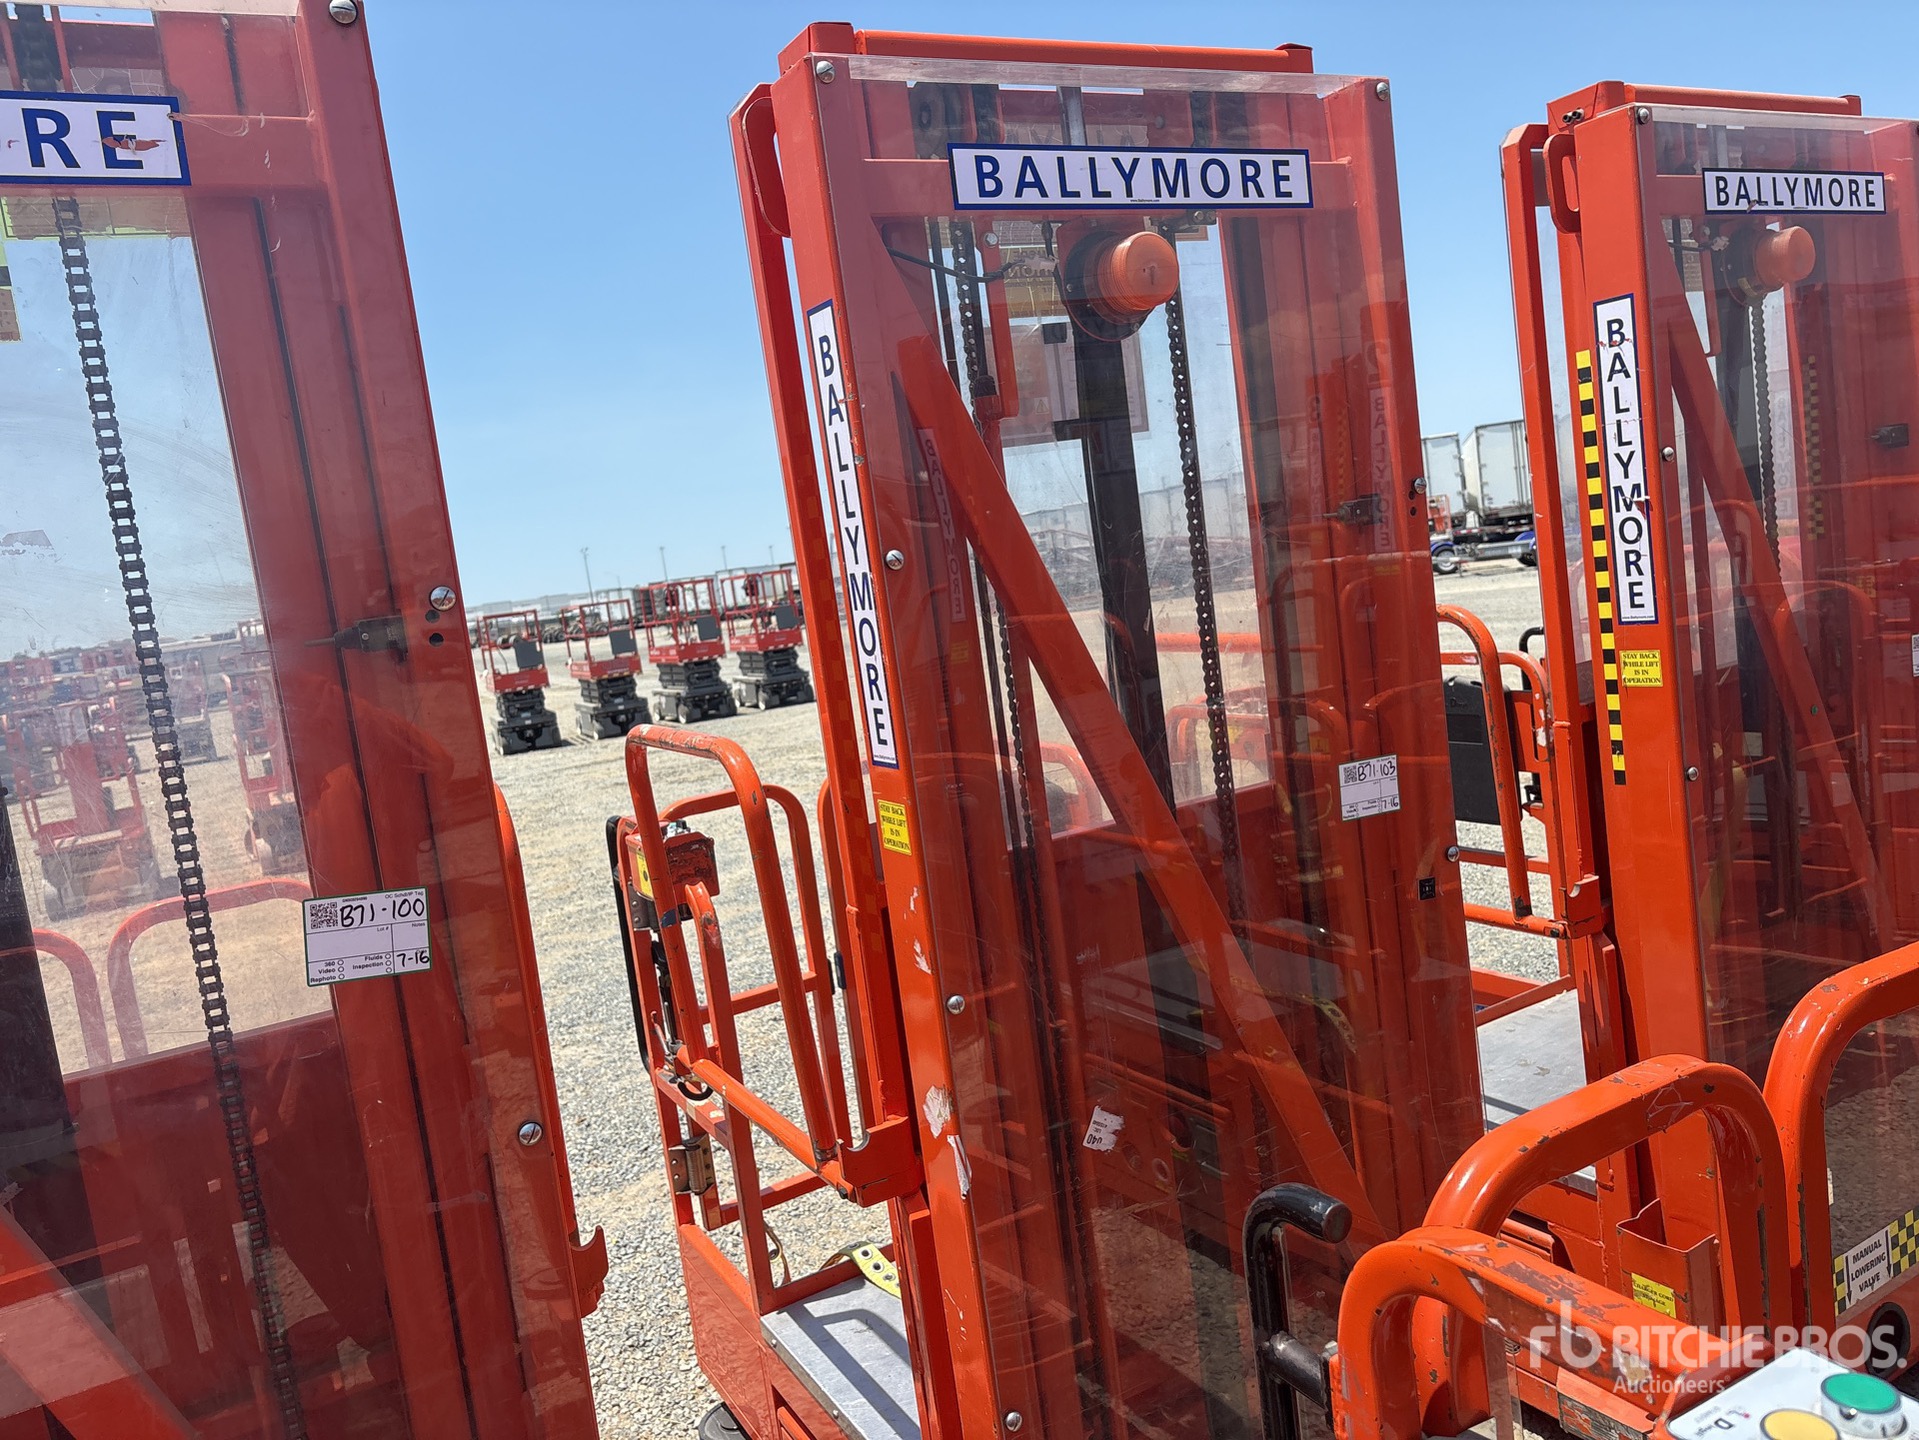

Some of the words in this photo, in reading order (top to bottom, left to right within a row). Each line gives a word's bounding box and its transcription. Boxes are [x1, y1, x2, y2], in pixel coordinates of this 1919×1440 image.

[973, 154, 1293, 199] BALLYMORE
[1715, 176, 1876, 208] BALLYMORE
[1606, 318, 1645, 609] BALLYMORE
[818, 334, 888, 746] BALLYMORE
[352, 962, 384, 970] Inspection
[1851, 1252, 1886, 1282] LOWERING
[1852, 1239, 1882, 1264] MANUAL
[1858, 1272, 1880, 1292] VALVE
